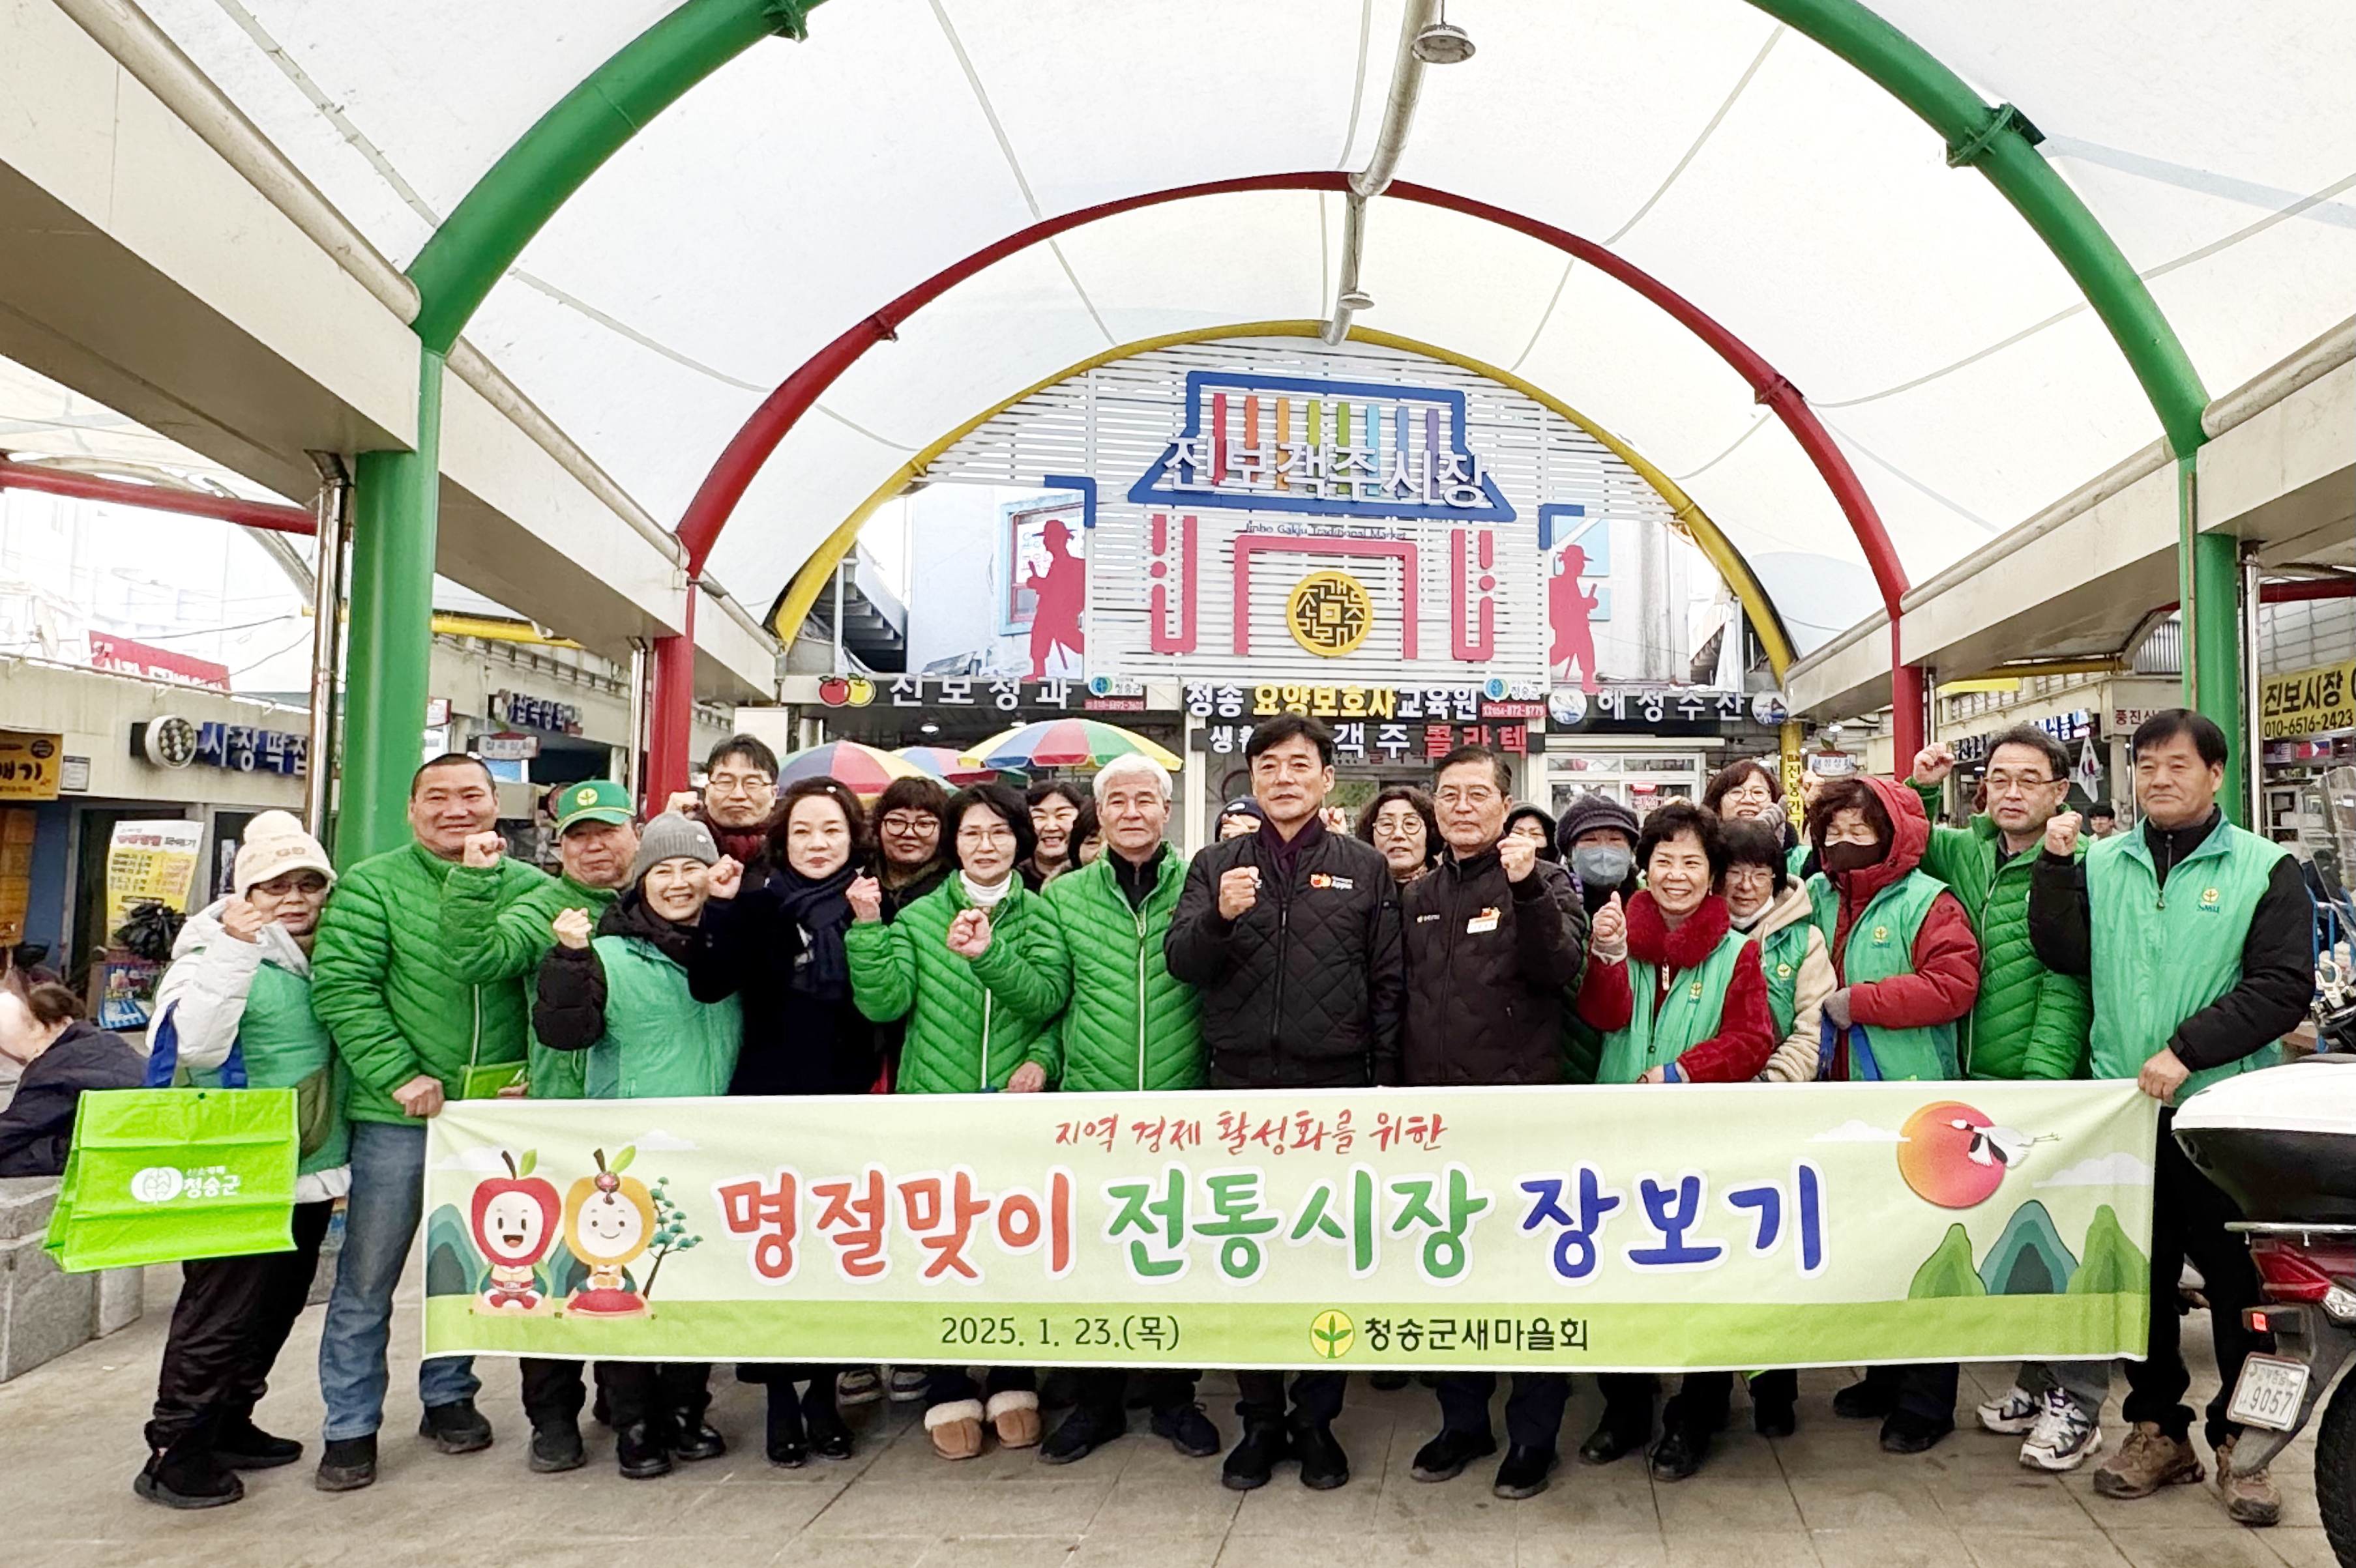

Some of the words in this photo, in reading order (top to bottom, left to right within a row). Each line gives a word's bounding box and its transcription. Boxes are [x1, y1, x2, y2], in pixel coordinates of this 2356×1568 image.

[1164, 436, 1488, 508] 진보객주시장
[1245, 519, 1273, 533] Jinbo
[1277, 524, 1308, 537] Gakju
[1370, 529, 1407, 540] Market
[889, 674, 1072, 711] 진보청과
[1186, 682, 1244, 718] 청송
[1598, 688, 1745, 722] 해성수산
[2264, 670, 2344, 718] 진보시장
[1333, 722, 1410, 759] 객주
[1424, 724, 1527, 759] 콜라텍
[2265, 708, 2353, 738] 010-6516-2423
[1055, 1114, 1119, 1153] 지역
[1131, 1115, 1202, 1152] 경제
[1216, 1109, 1357, 1156] 활성화를
[1368, 1111, 1449, 1151] 위한
[184, 1175, 242, 1198] 청송군
[718, 1169, 1069, 1279] 명절맞이
[1107, 1167, 1489, 1279] 전통시장
[1522, 1163, 1824, 1279] 장보기
[941, 1316, 1025, 1346] 2025.
[1038, 1317, 1061, 1346] 1.
[1076, 1316, 1181, 1352] 23.(목)
[1365, 1316, 1589, 1352] 청송군새마을회
